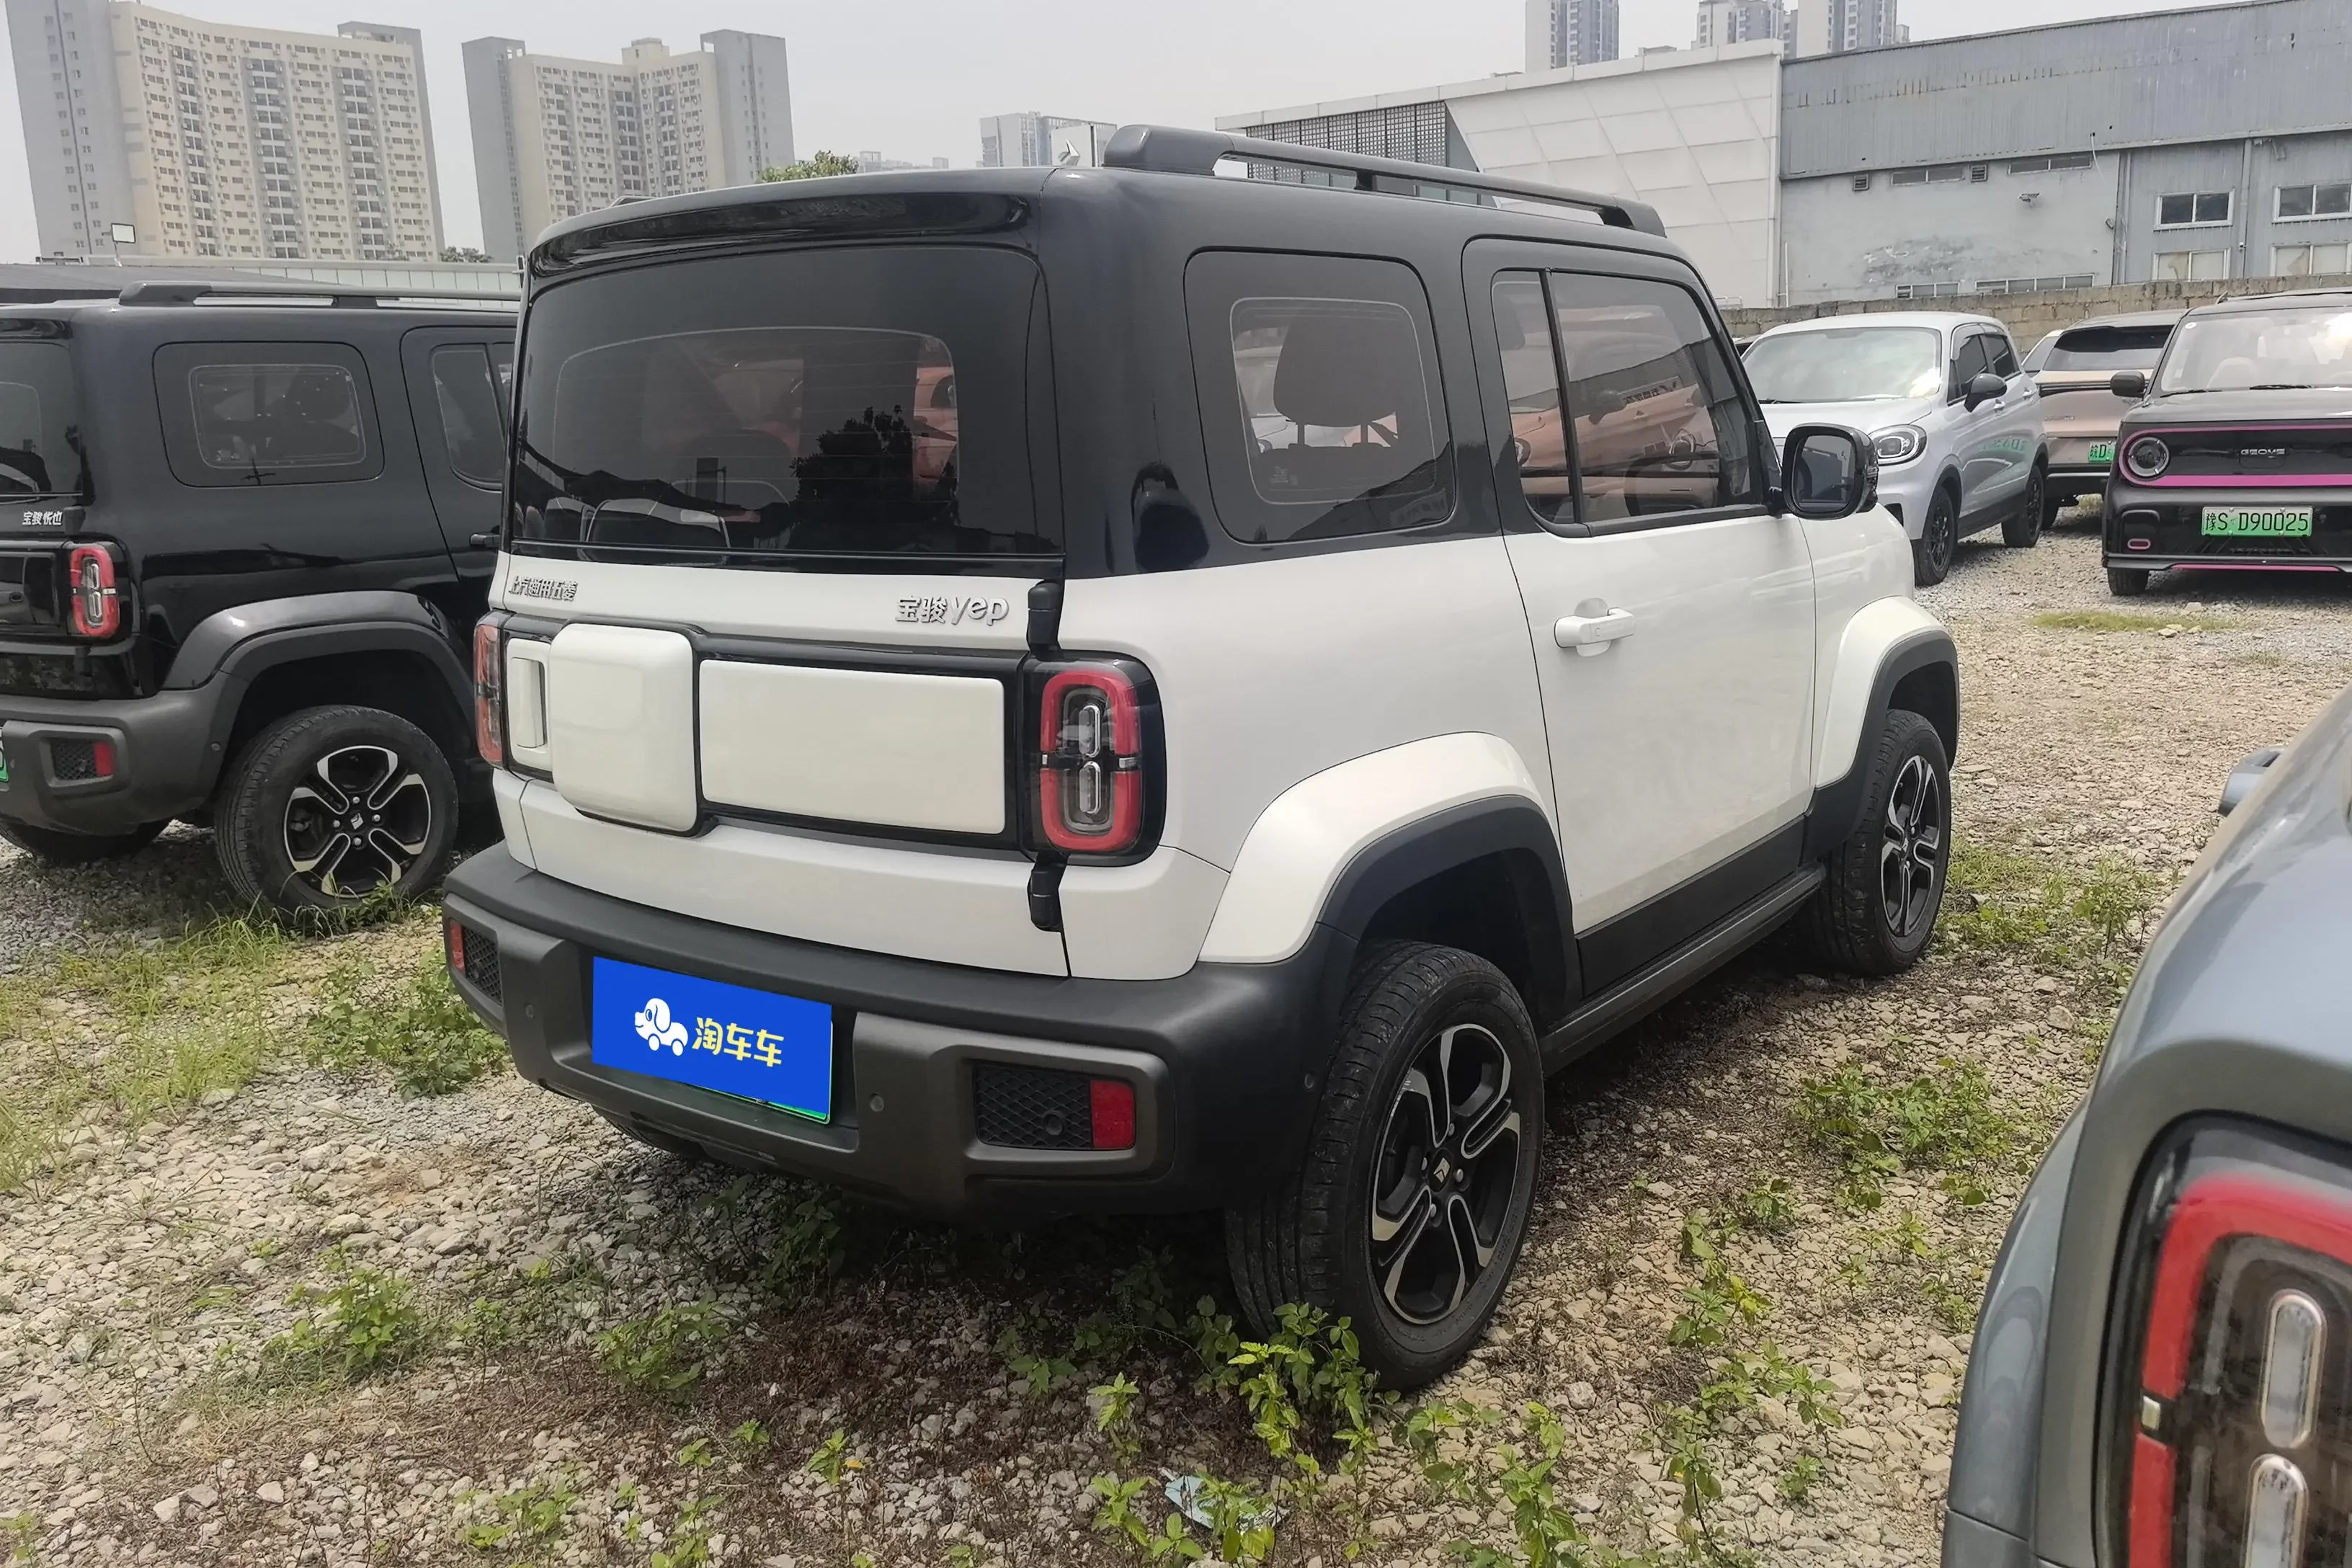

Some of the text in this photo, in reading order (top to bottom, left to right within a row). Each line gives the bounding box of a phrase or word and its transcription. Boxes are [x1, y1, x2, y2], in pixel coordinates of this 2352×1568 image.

[2237, 512, 2308, 532] D90025
[508, 575, 578, 602] 上汽通用五菱
